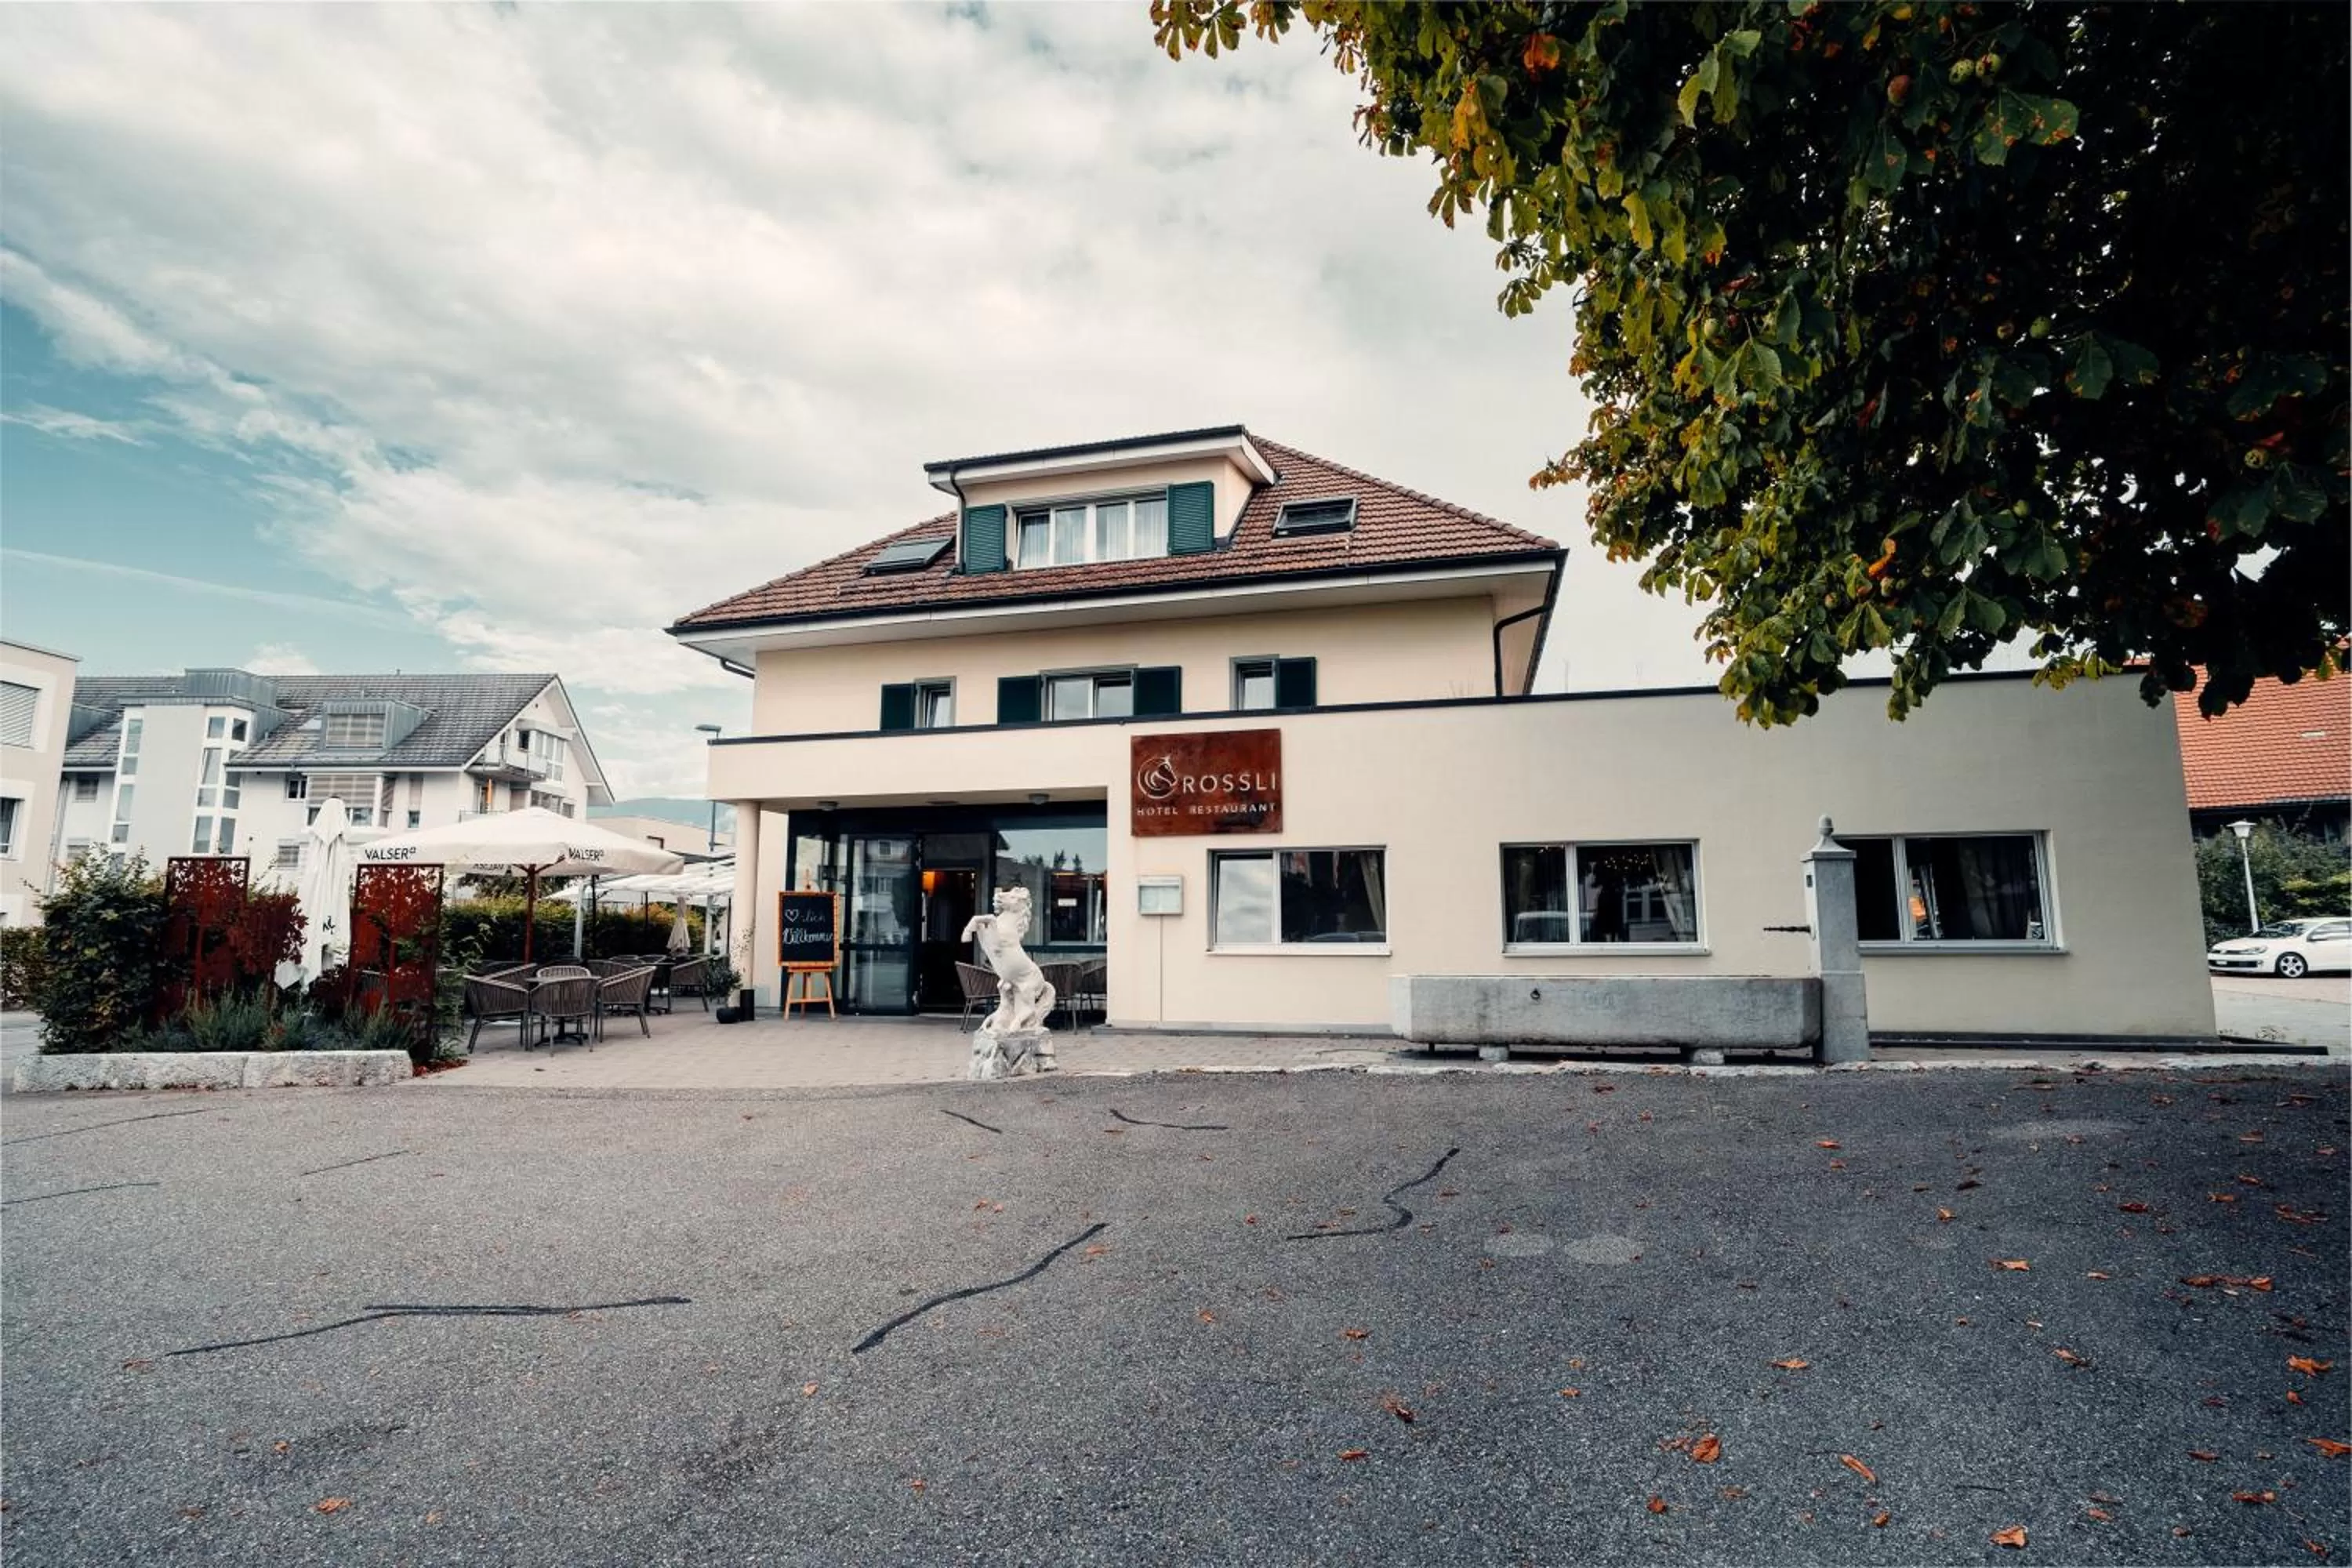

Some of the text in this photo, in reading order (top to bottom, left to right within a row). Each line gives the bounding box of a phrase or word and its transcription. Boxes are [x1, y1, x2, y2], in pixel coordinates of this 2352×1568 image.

[1137, 802, 1276, 816] HOTEL RESTAURANT
[365, 848, 408, 860] VALSER
[568, 848, 600, 861] VALSER
